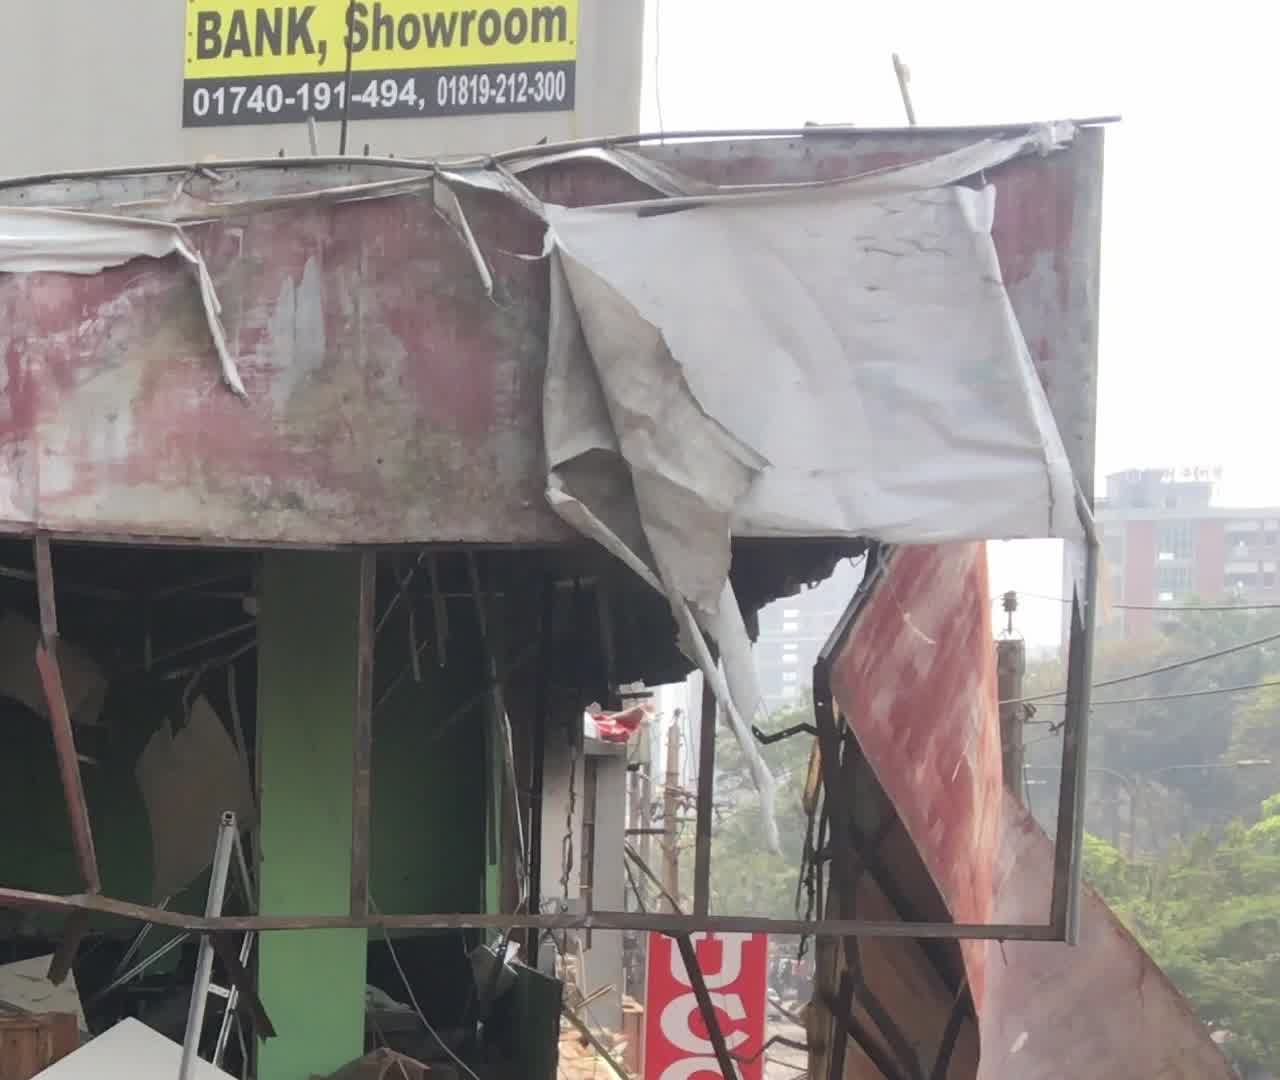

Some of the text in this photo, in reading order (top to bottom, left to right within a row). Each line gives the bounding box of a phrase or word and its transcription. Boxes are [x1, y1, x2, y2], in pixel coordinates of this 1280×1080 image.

[197, 1, 567, 66] BANK, Showroom
[192, 70, 566, 116] 01740-191-494, 01819-212-300
